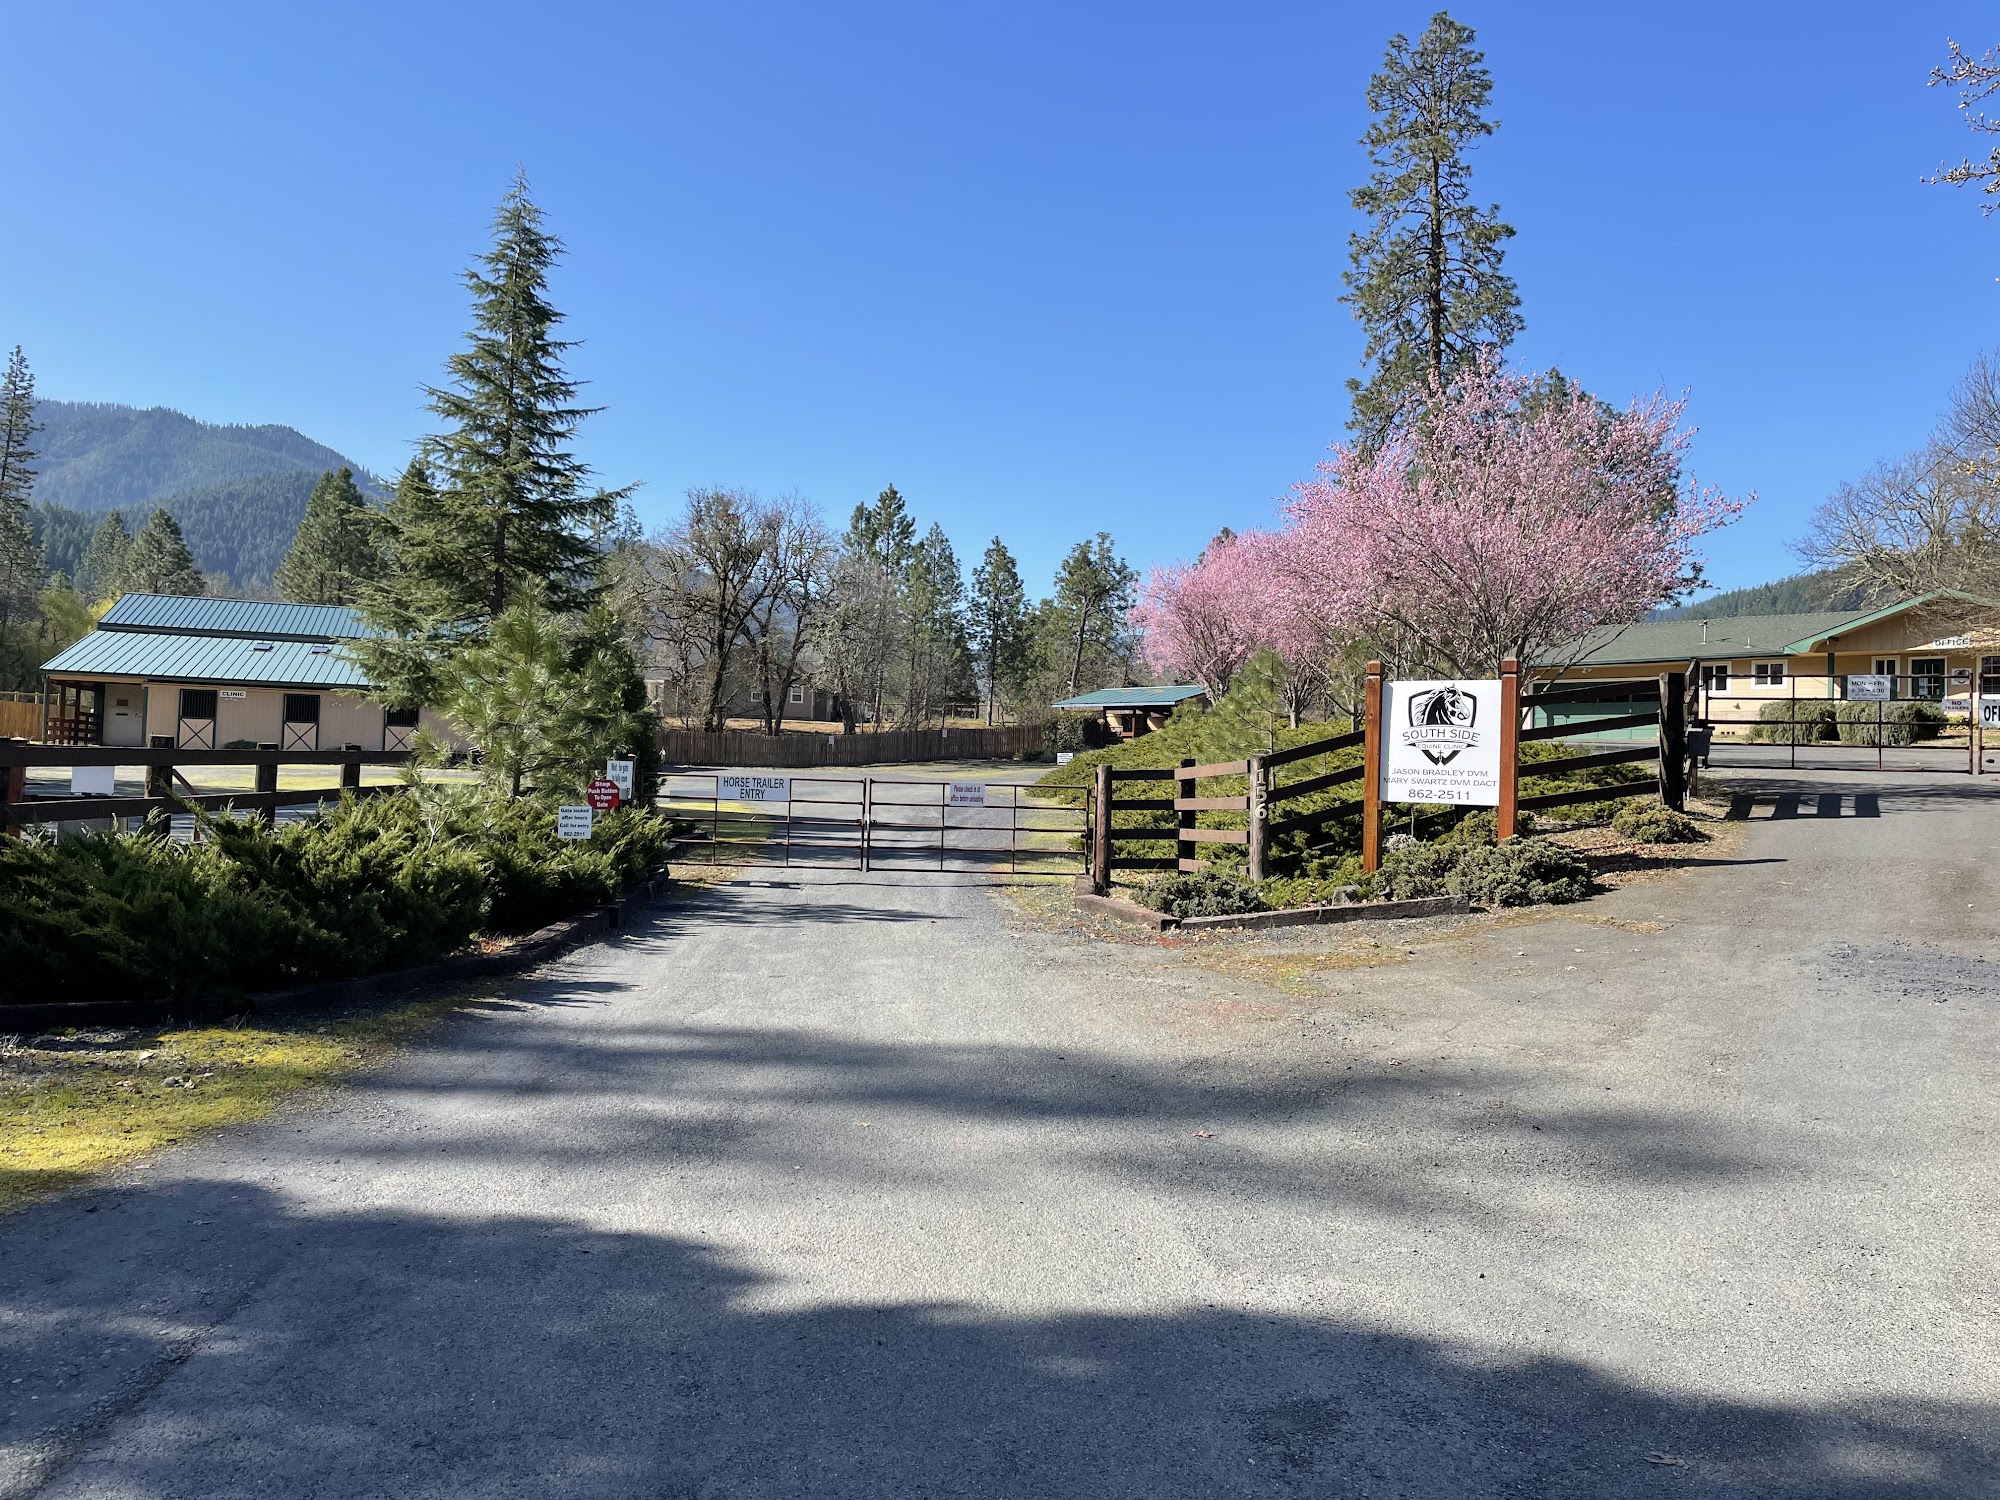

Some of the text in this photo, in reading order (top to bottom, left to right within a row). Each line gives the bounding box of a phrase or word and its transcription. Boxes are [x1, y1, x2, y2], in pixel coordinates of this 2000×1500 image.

[1935, 638, 1969, 646] OFFICE
[1402, 728, 1480, 742] SOUTH SIDE
[724, 776, 784, 788] HORSE TRAILER
[1411, 778, 1448, 786] SWARTZ
[954, 784, 964, 792] Please
[740, 788, 766, 800] ENTRY
[1255, 768, 1268, 820] 156
[1408, 789, 1470, 800] 862-2511
